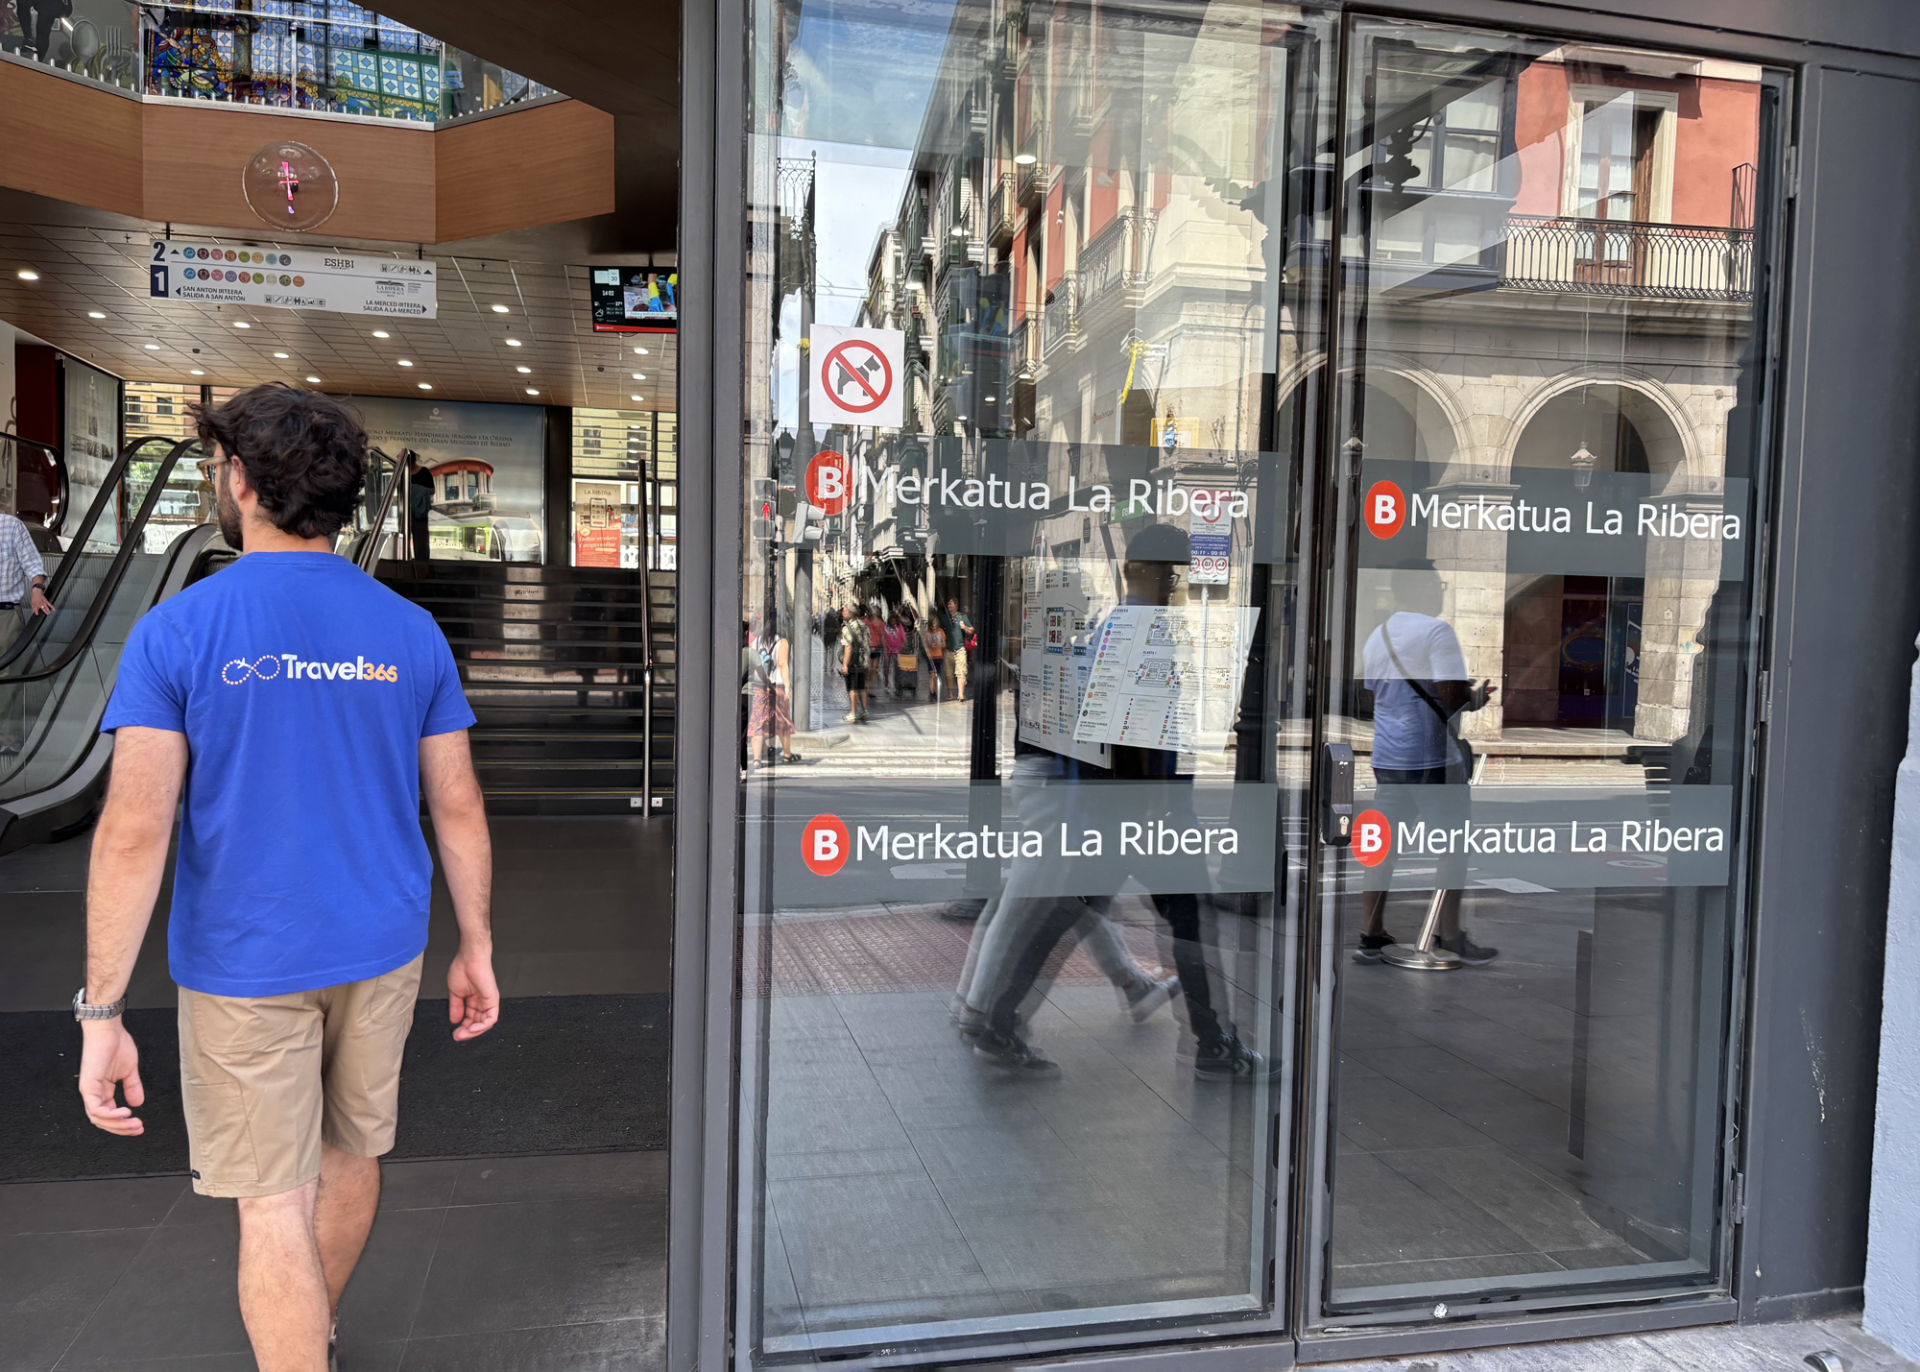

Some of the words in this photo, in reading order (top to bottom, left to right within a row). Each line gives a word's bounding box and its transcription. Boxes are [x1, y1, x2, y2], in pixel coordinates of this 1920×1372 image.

[153, 242, 166, 262] 2
[324, 258, 355, 269] ESHBI
[154, 271, 165, 292] 1
[861, 465, 1050, 510] Merkatua
[1068, 476, 1111, 513] La
[1129, 478, 1249, 518] Ribera
[1411, 493, 1571, 533] Merkatua
[1586, 501, 1623, 535] La
[1637, 503, 1741, 540] Ribera
[281, 653, 398, 683] Travel365
[856, 822, 1043, 861] Merkatua
[1061, 822, 1102, 856] La
[1120, 820, 1239, 855] Ribera
[1397, 820, 1556, 854] Merkatua
[1570, 820, 1607, 852] La
[1621, 819, 1724, 852] Ribera
